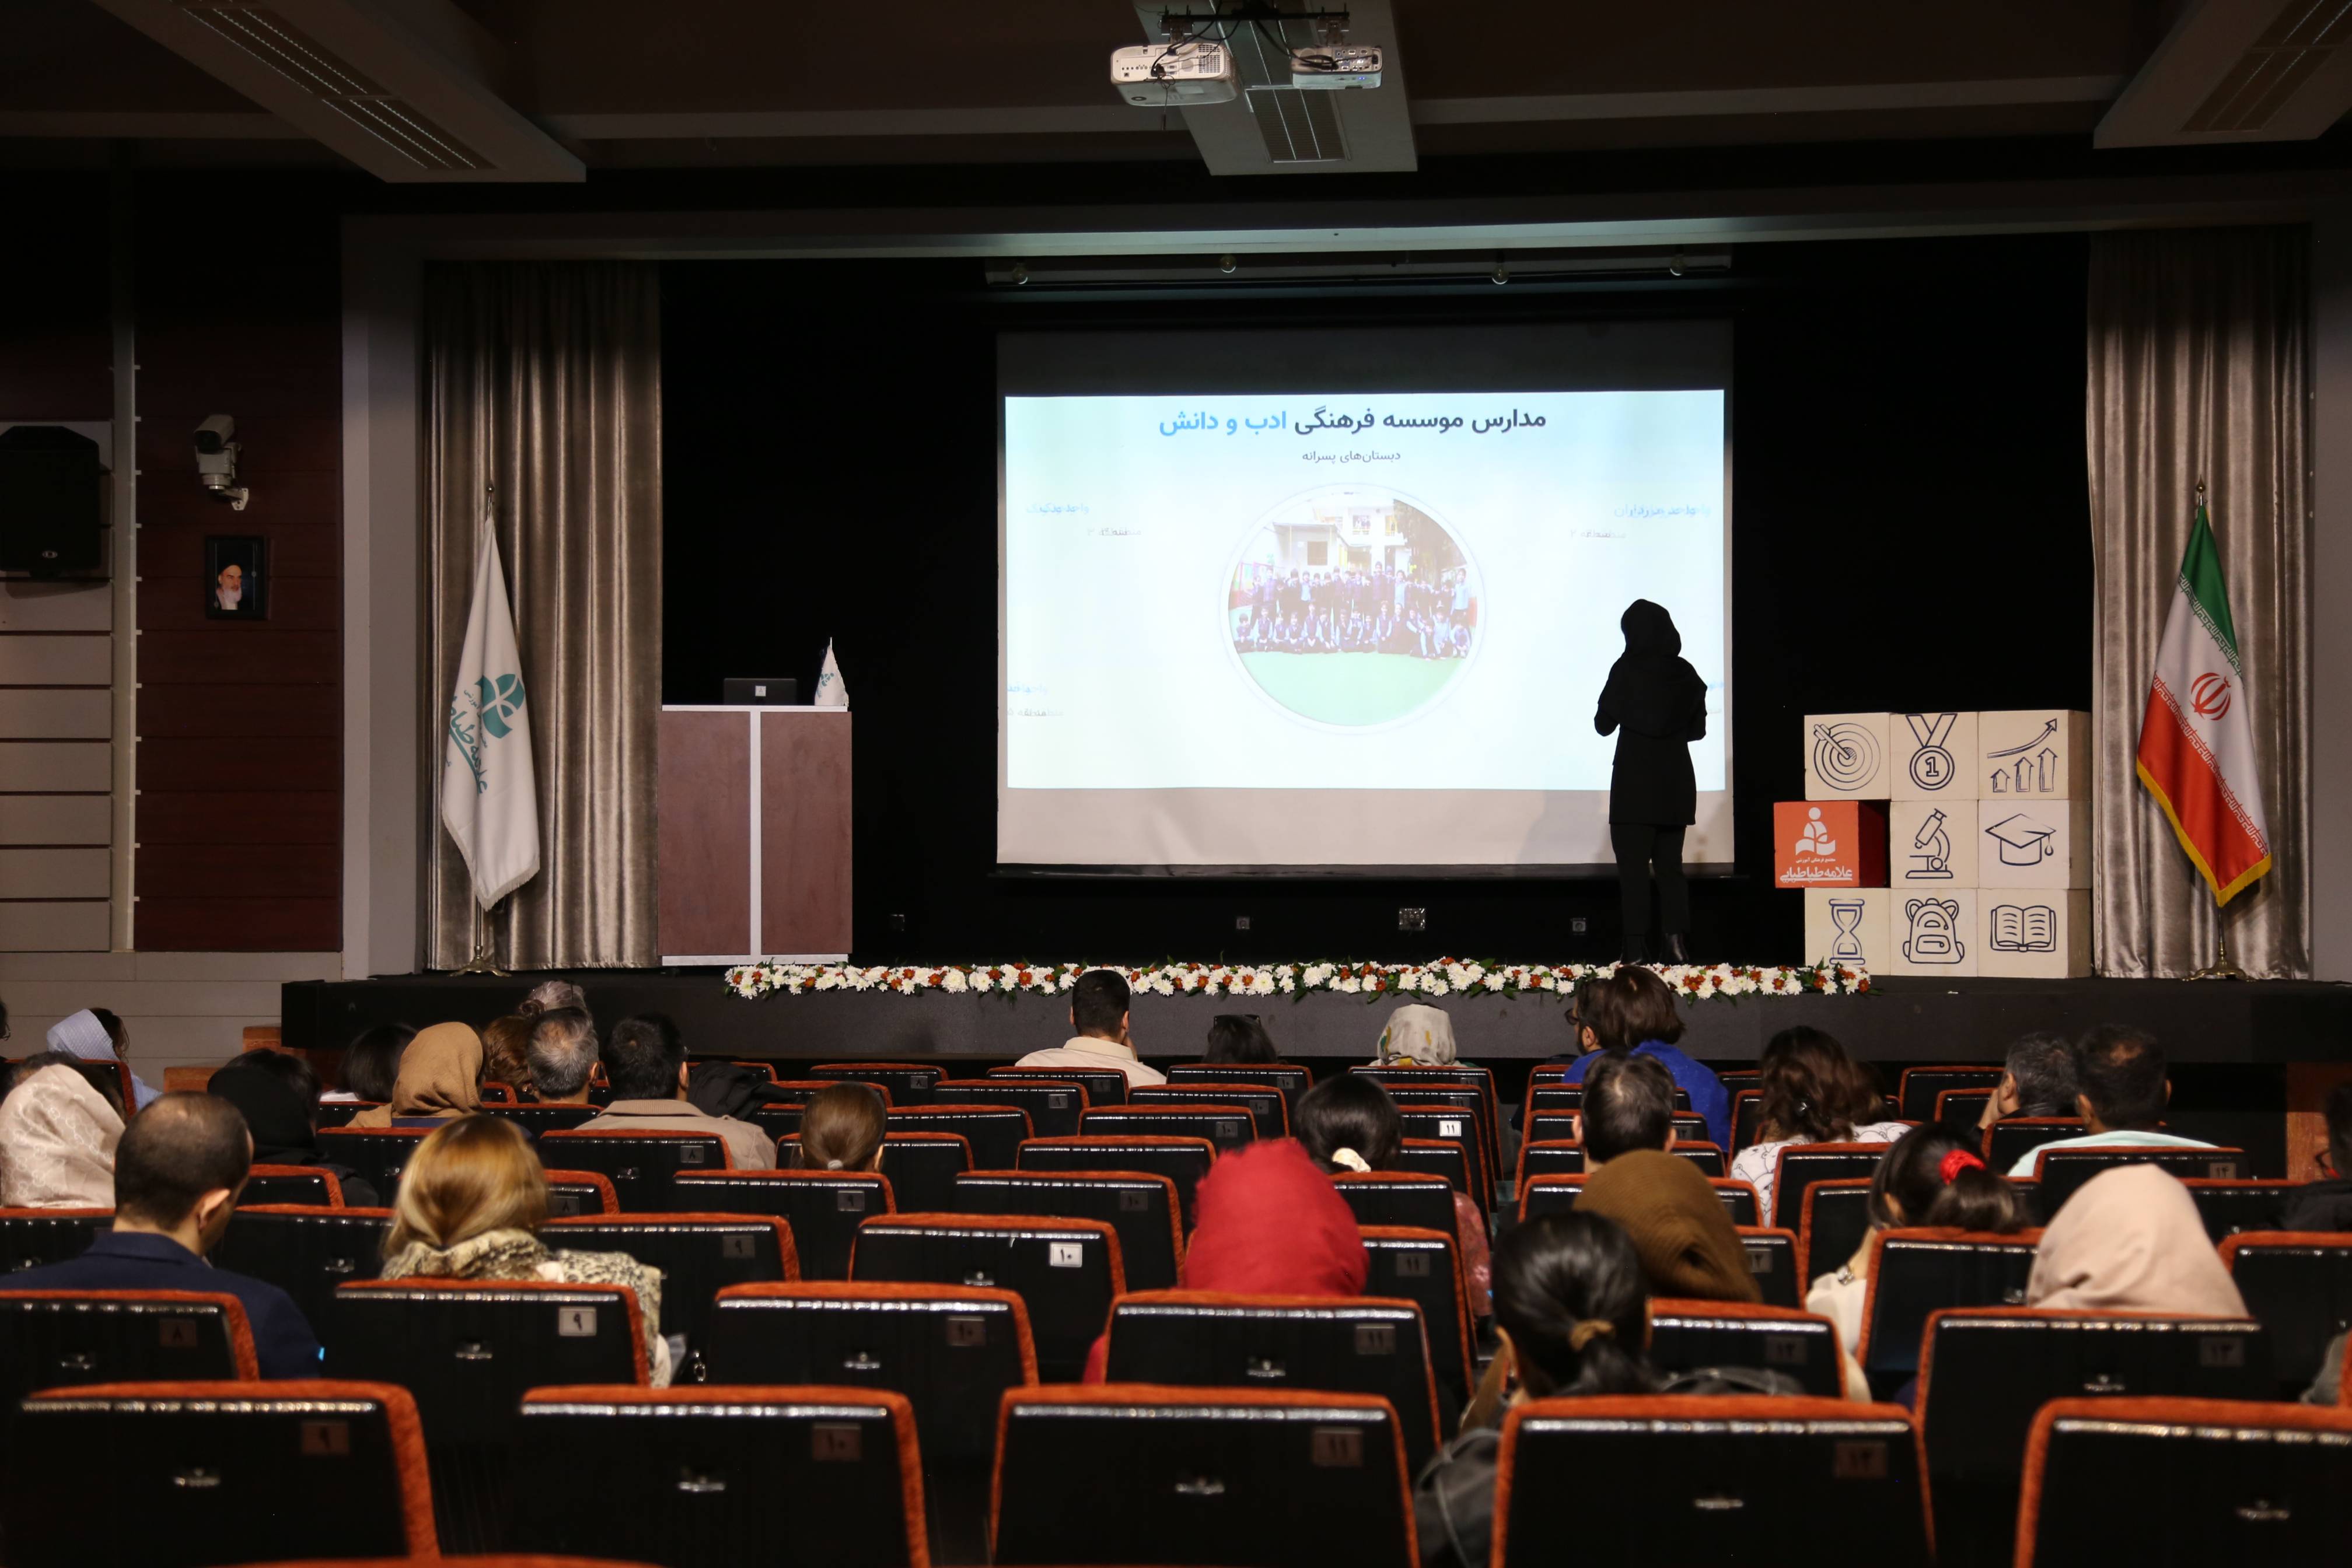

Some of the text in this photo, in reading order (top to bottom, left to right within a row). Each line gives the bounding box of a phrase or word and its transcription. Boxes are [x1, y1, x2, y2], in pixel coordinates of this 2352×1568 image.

[1159, 404, 1546, 437] مدارس موسسه فرهنگی ادب و دانش
[1302, 450, 1336, 464] پسرانه
[1925, 756, 1939, 777] 1
[1824, 865, 1853, 878] علامه
[1446, 1124, 1455, 1134] ۱۱
[689, 1149, 696, 1159] ۸
[562, 1199, 571, 1212] ۸
[1128, 1195, 1140, 1208] ۱۰
[735, 1240, 743, 1255] ۹
[1060, 1248, 1072, 1263] ۱۰
[1406, 1256, 1420, 1272] ۱۱
[572, 1313, 582, 1331] ۹
[958, 1323, 973, 1340] ۱۰
[1367, 1331, 1385, 1347] ۱۱
